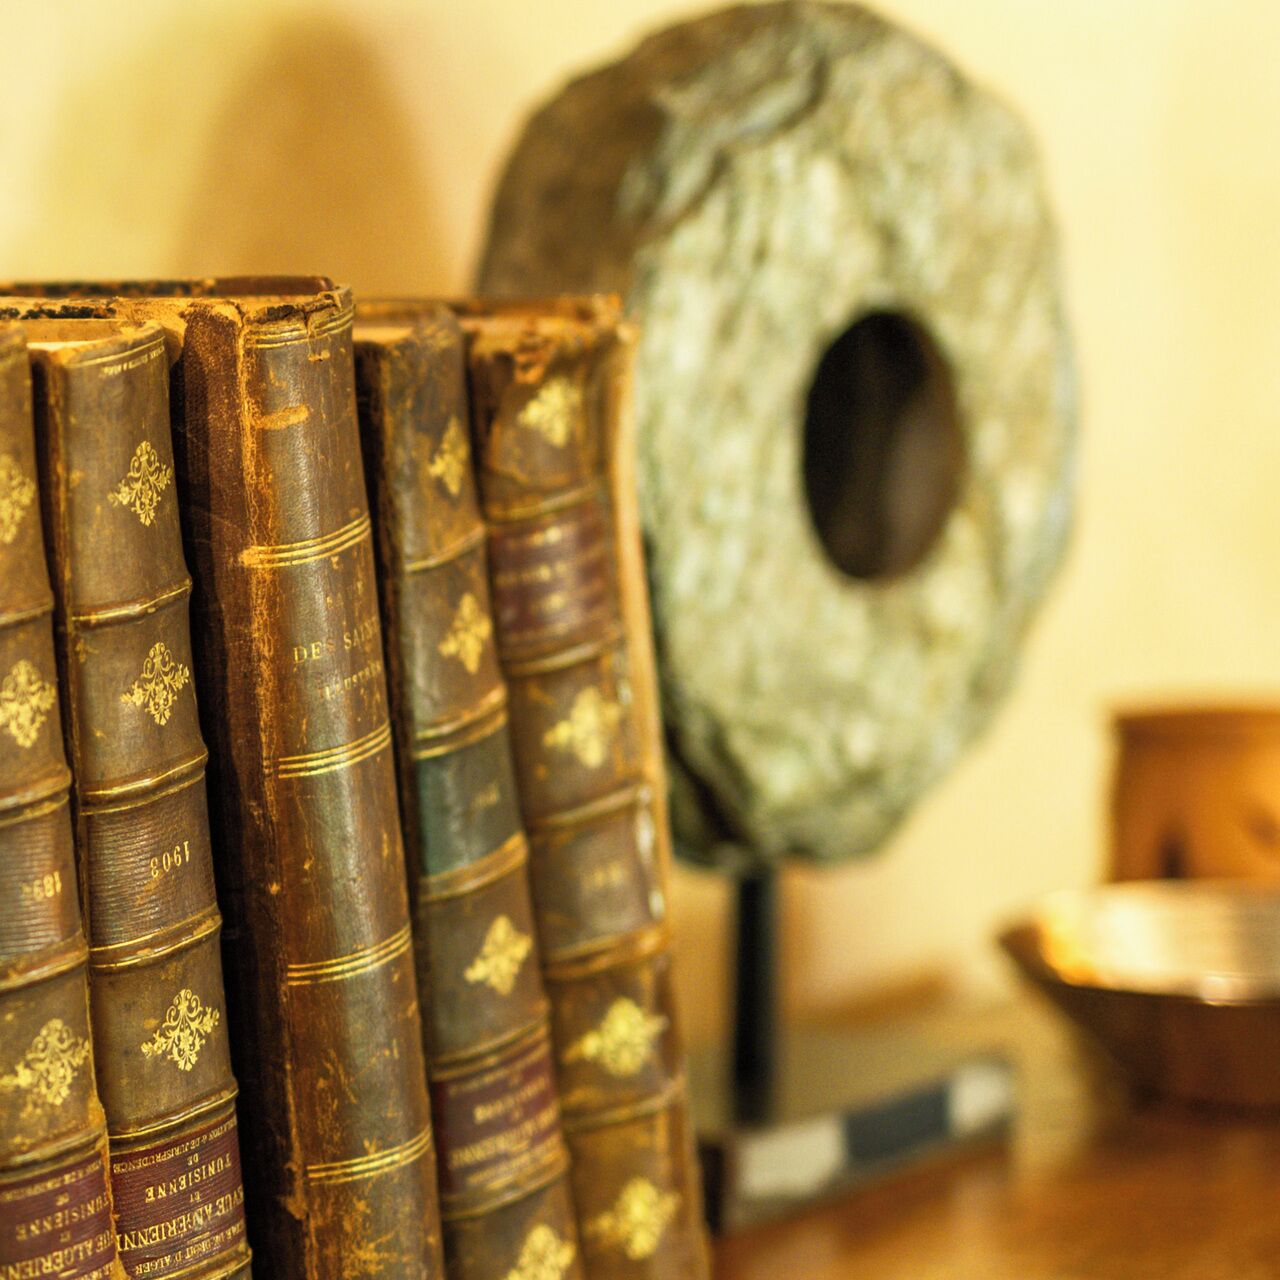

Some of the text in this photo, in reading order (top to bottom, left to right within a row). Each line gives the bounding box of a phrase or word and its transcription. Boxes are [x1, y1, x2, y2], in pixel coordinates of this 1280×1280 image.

[150, 840, 190, 878] 1903
[113, 1143, 190, 1174] JURISPRUDENCE
[187, 1153, 199, 1166] DE
[145, 1153, 231, 1203] TUNISIENNE
